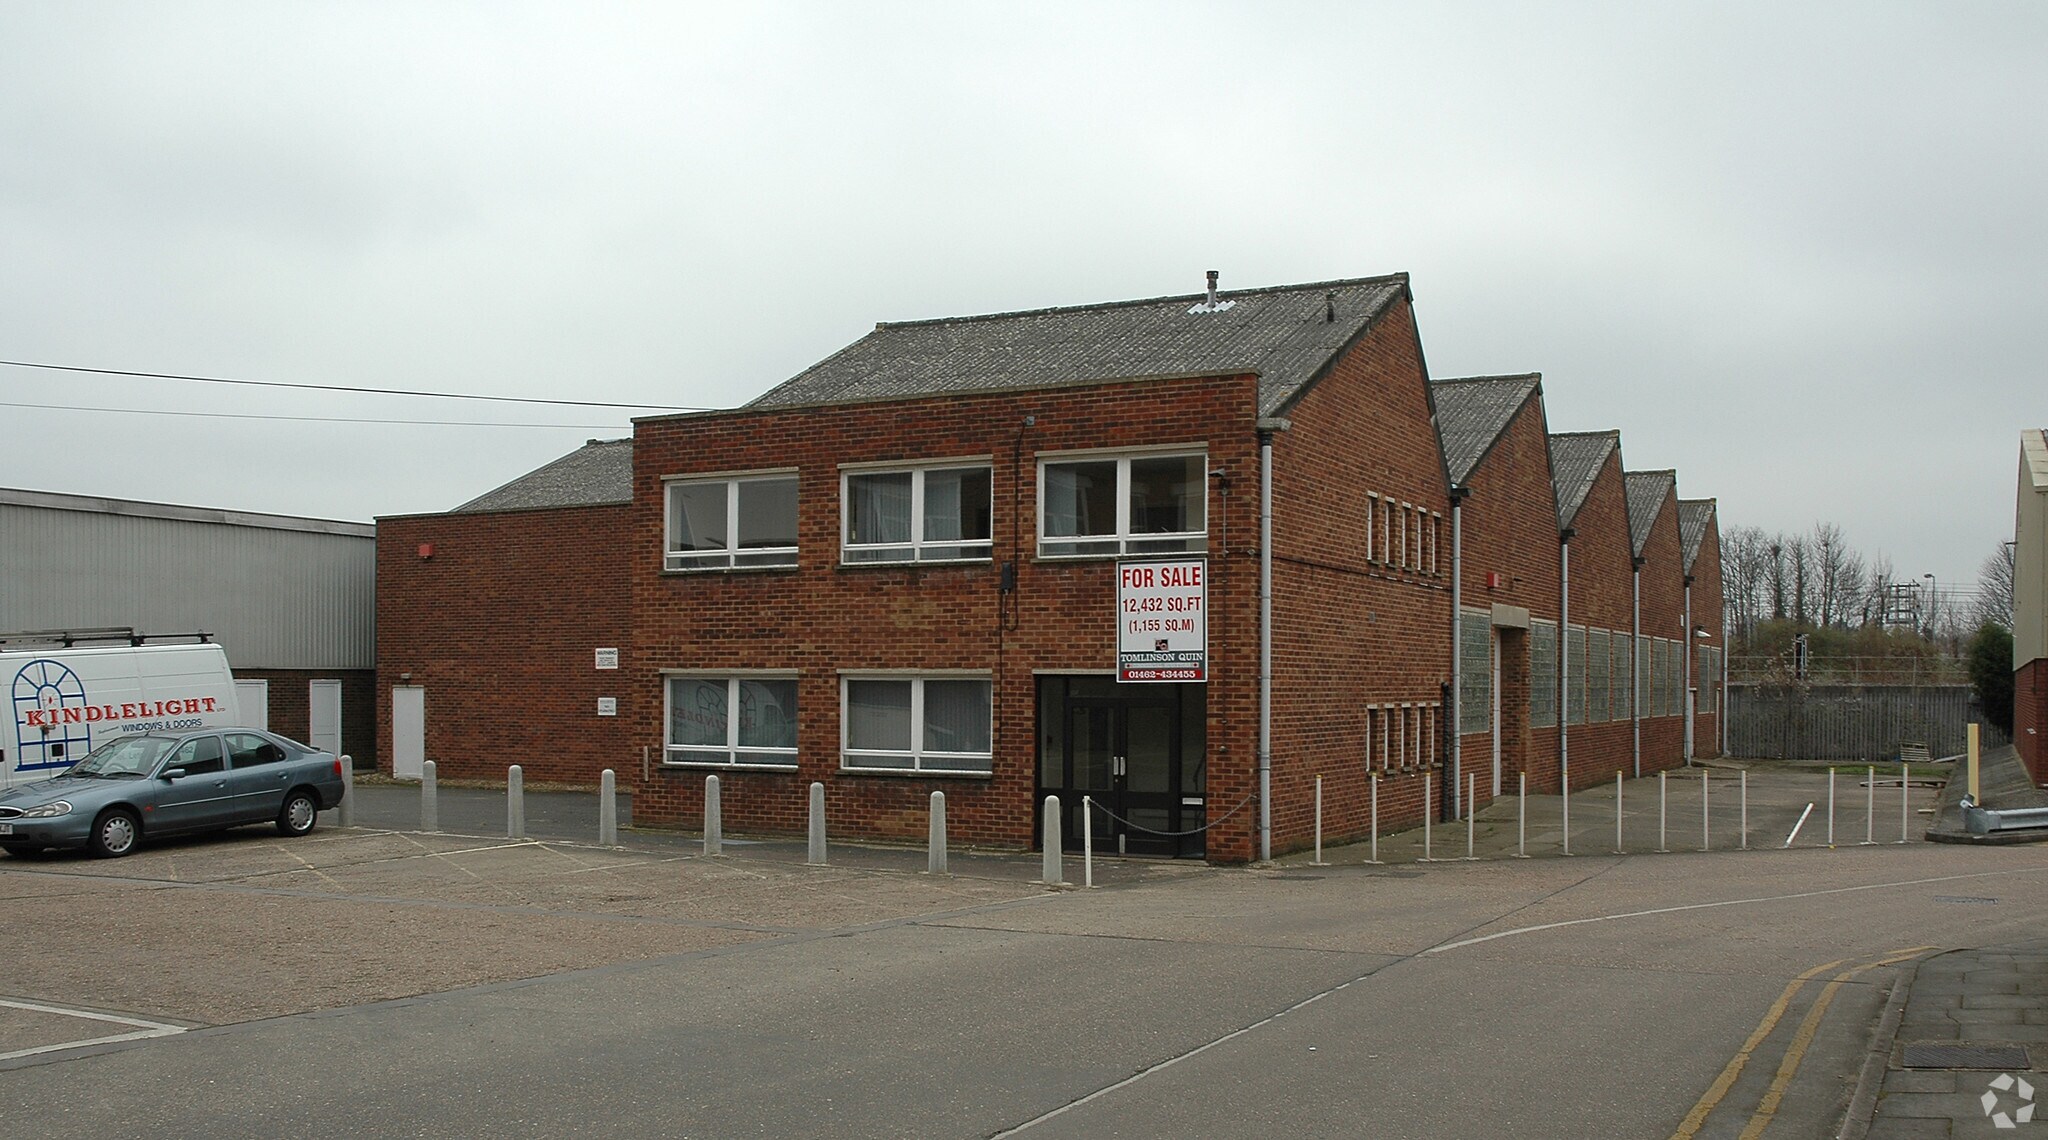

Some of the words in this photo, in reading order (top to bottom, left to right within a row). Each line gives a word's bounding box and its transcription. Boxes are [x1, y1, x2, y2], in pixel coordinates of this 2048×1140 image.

[1122, 568, 1154, 588] FOR
[1160, 566, 1201, 587] SALE
[1123, 597, 1163, 614] 12,432
[1167, 596, 1201, 613] SQ.FT
[1128, 619, 1160, 634] (1,155
[1165, 618, 1195, 633] SQ.M)
[1120, 653, 1175, 662] TOMLINSON
[1178, 652, 1203, 661] QUIN
[1128, 670, 1196, 679] 01462-434455
[25, 697, 217, 727] KINDLELIGHT
[121, 721, 163, 733] WINDOWS
[165, 720, 171, 729] &
[173, 718, 203, 729] DOORS
